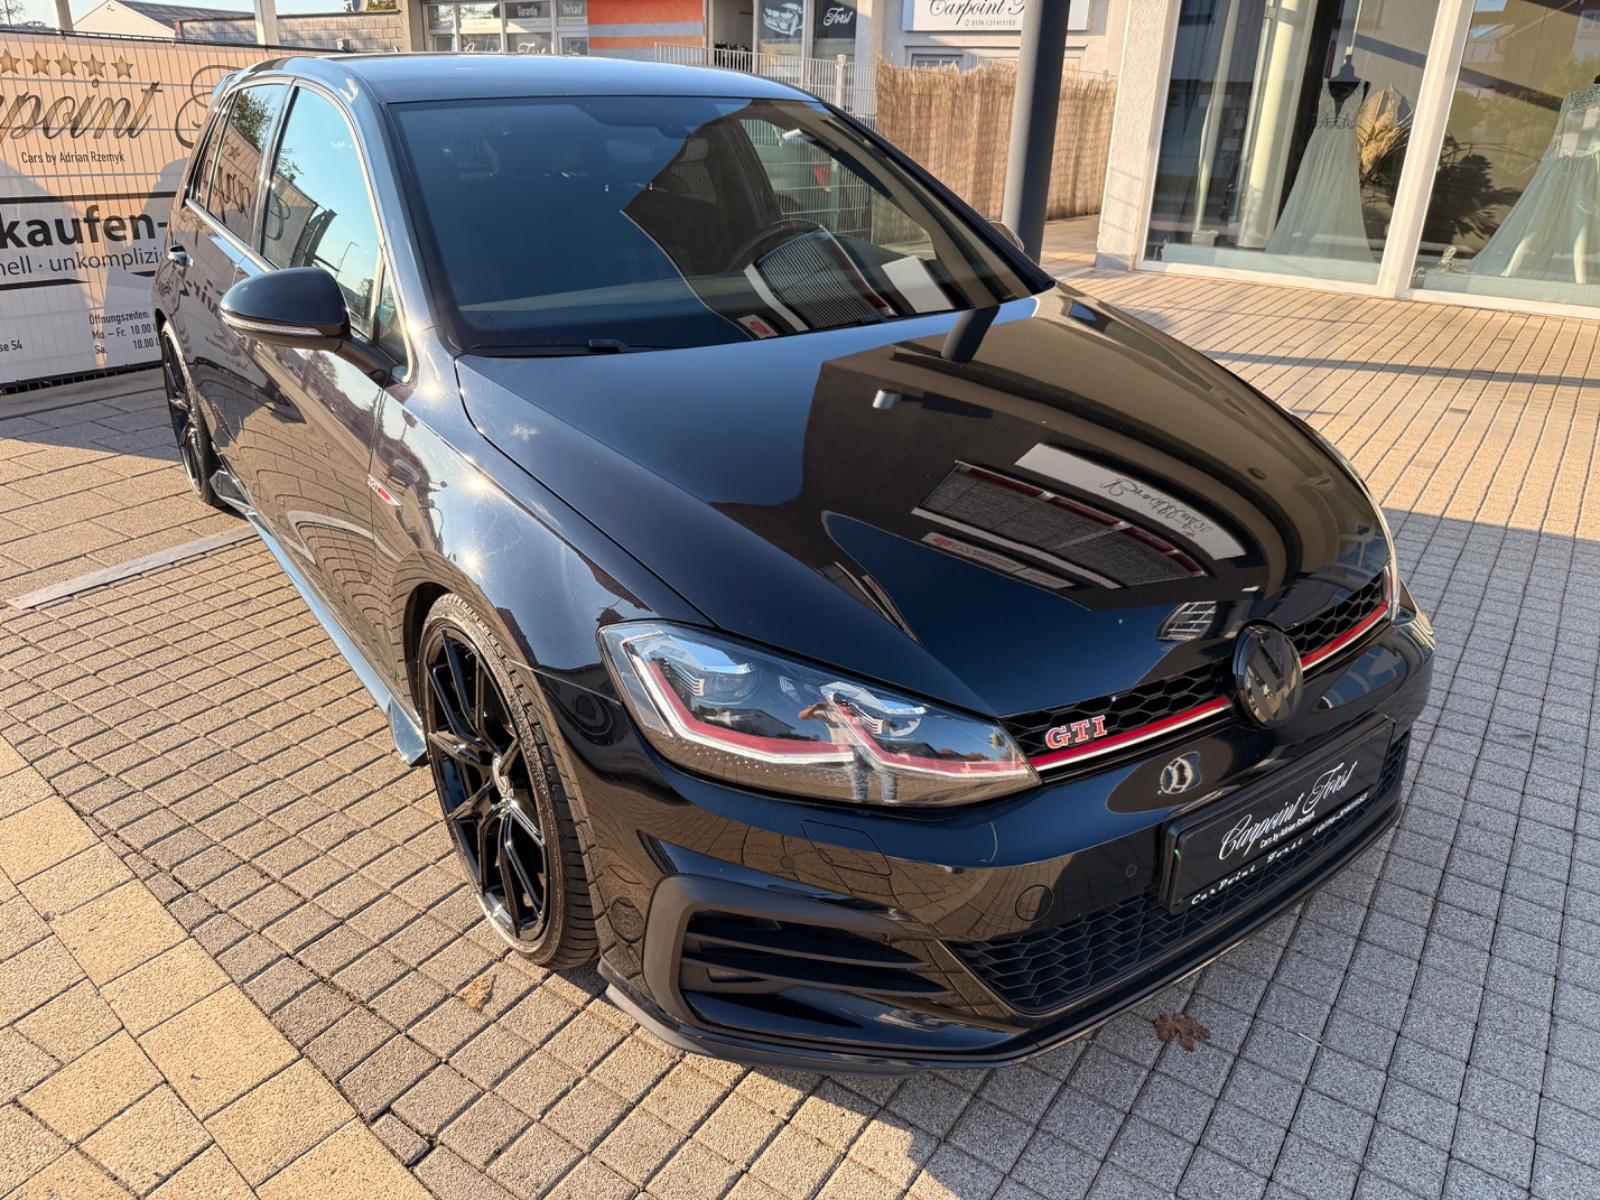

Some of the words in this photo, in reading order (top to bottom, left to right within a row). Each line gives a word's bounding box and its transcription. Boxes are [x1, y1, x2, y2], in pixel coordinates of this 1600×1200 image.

[517, 6, 538, 17] Garantie
[823, 7, 854, 26] Forst
[0, 78, 163, 145] point
[21, 152, 44, 164] Cars
[46, 151, 57, 165] by
[59, 151, 89, 164] Adrian
[90, 151, 125, 164] Rzemyk
[89, 310, 151, 326] Öffnungszeiten:
[92, 328, 107, 341] Mo.
[116, 326, 127, 338] Fr.
[130, 323, 152, 336] 10.00
[11, 339, 23, 351] 54
[94, 344, 108, 355] Sa.
[133, 338, 154, 350] 10.00
[1045, 714, 1108, 750] GTI
[1218, 791, 1305, 860] Carpoint
